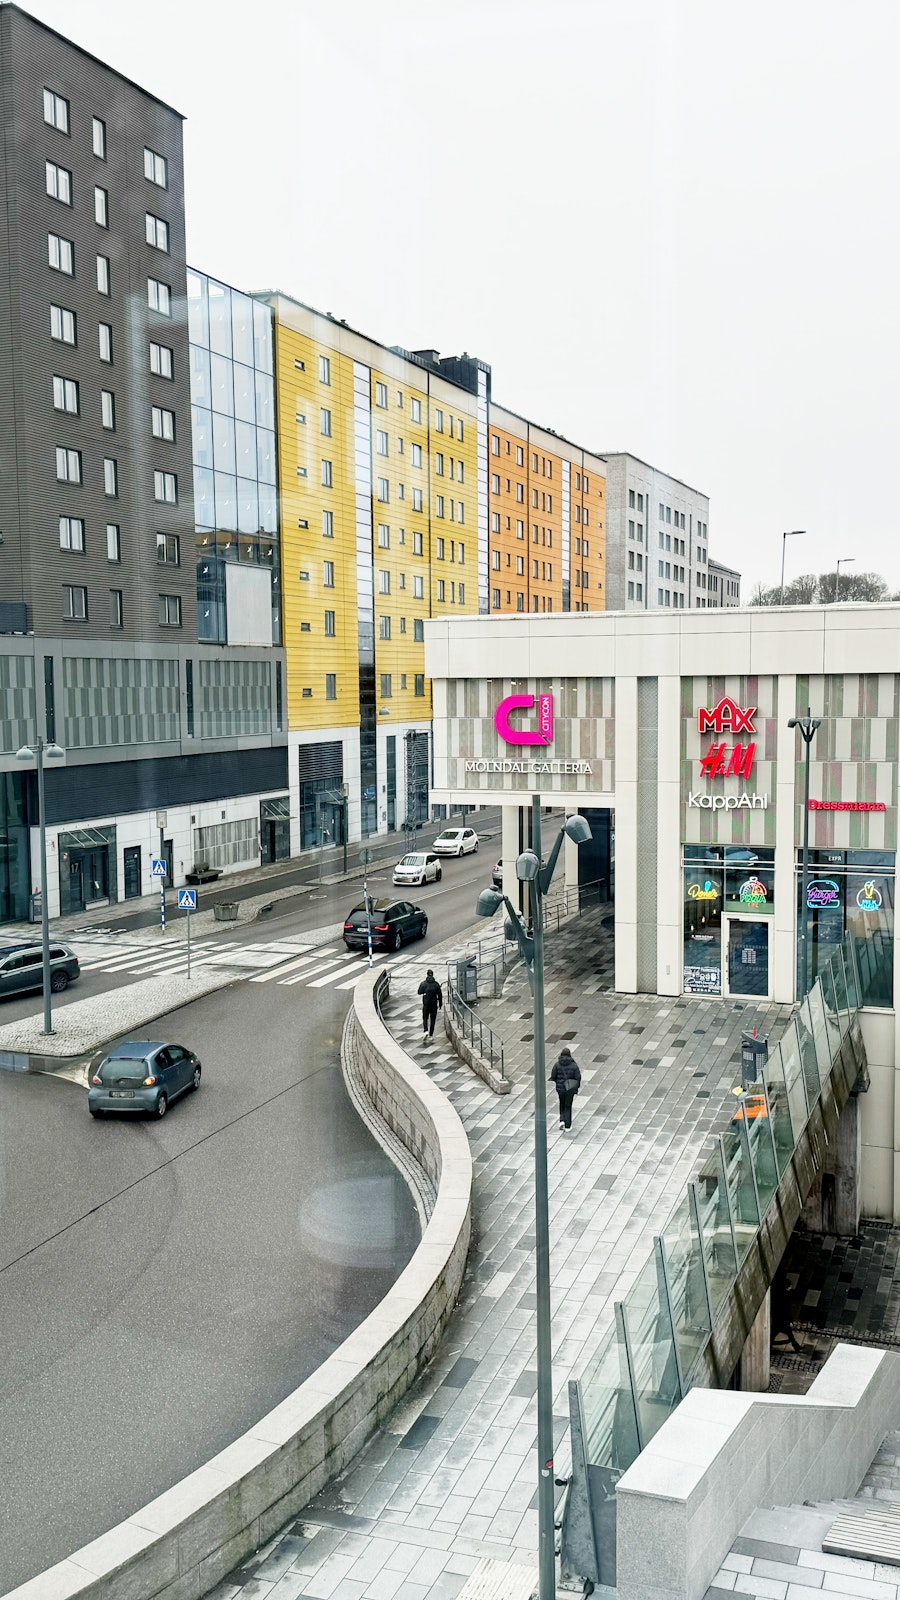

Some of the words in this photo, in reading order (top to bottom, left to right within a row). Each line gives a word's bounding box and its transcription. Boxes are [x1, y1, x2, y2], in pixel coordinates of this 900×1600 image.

[541, 697, 550, 731] CITYCON
[697, 696, 758, 734] MAX
[531, 762, 593, 775] GALLERIA
[699, 742, 757, 780] H&M
[688, 791, 768, 811] KappAhl
[808, 798, 886, 812] Dressmann
[71, 862, 79, 873] 17
